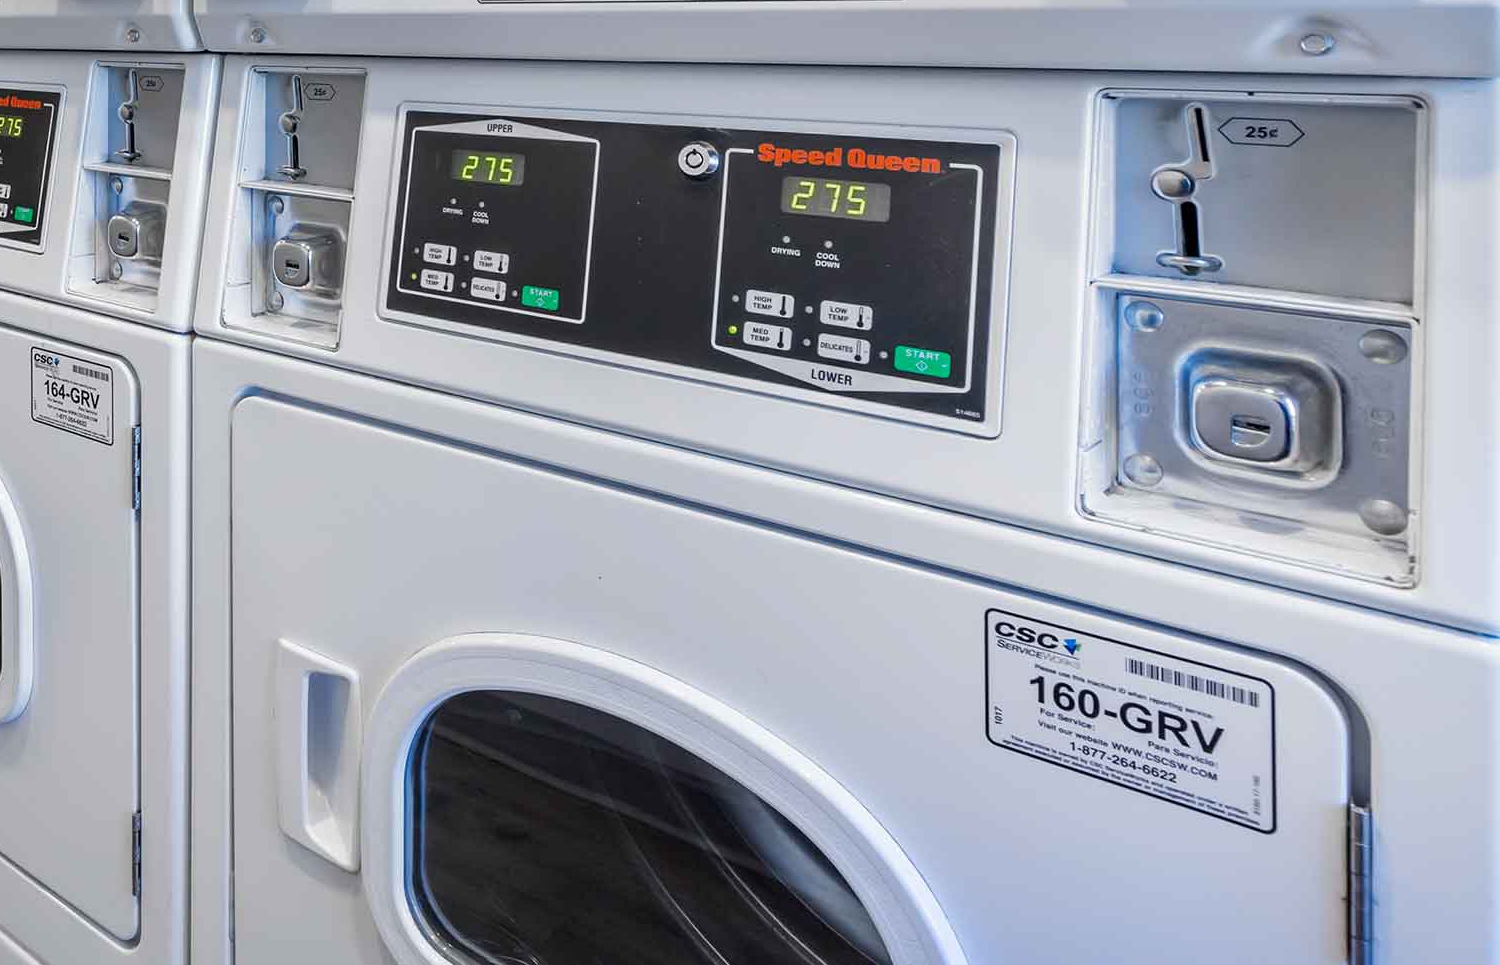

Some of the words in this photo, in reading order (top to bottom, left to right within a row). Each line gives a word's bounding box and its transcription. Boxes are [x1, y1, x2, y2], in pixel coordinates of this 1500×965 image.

[486, 123, 513, 134] UPPER
[1244, 124, 1279, 140] 25¢
[757, 143, 843, 167] Speed
[847, 148, 941, 174] Queen
[462, 156, 514, 183] 275
[791, 181, 866, 215] 275
[473, 210, 489, 219] COOL
[771, 247, 800, 257] DRYING
[816, 252, 840, 261] COOL
[815, 260, 840, 269] DOWN
[529, 288, 552, 297] START
[752, 302, 772, 310] TEMP
[829, 306, 848, 314] LOW
[828, 313, 849, 322] TEMP
[752, 327, 769, 335] MED
[750, 334, 770, 343] TEMP
[820, 342, 853, 353] DELICATES
[34, 353, 53, 365] CSC
[905, 348, 940, 361] START
[811, 369, 852, 386] LOWER
[44, 380, 100, 409] 164-GRV
[995, 622, 1059, 649] CSC
[994, 706, 1003, 725] 1017
[1030, 675, 1225, 754] 160-GRV
[1040, 708, 1055, 717] For
[1058, 713, 1095, 731] Service:
[1038, 720, 1056, 731] Visit
[1058, 728, 1072, 736] our
[1075, 733, 1109, 747] website
[1111, 741, 1218, 781] WWW.CSCSW.COM
[1148, 741, 1170, 753] Para
[1070, 741, 1177, 783] 1-877-264-6622
